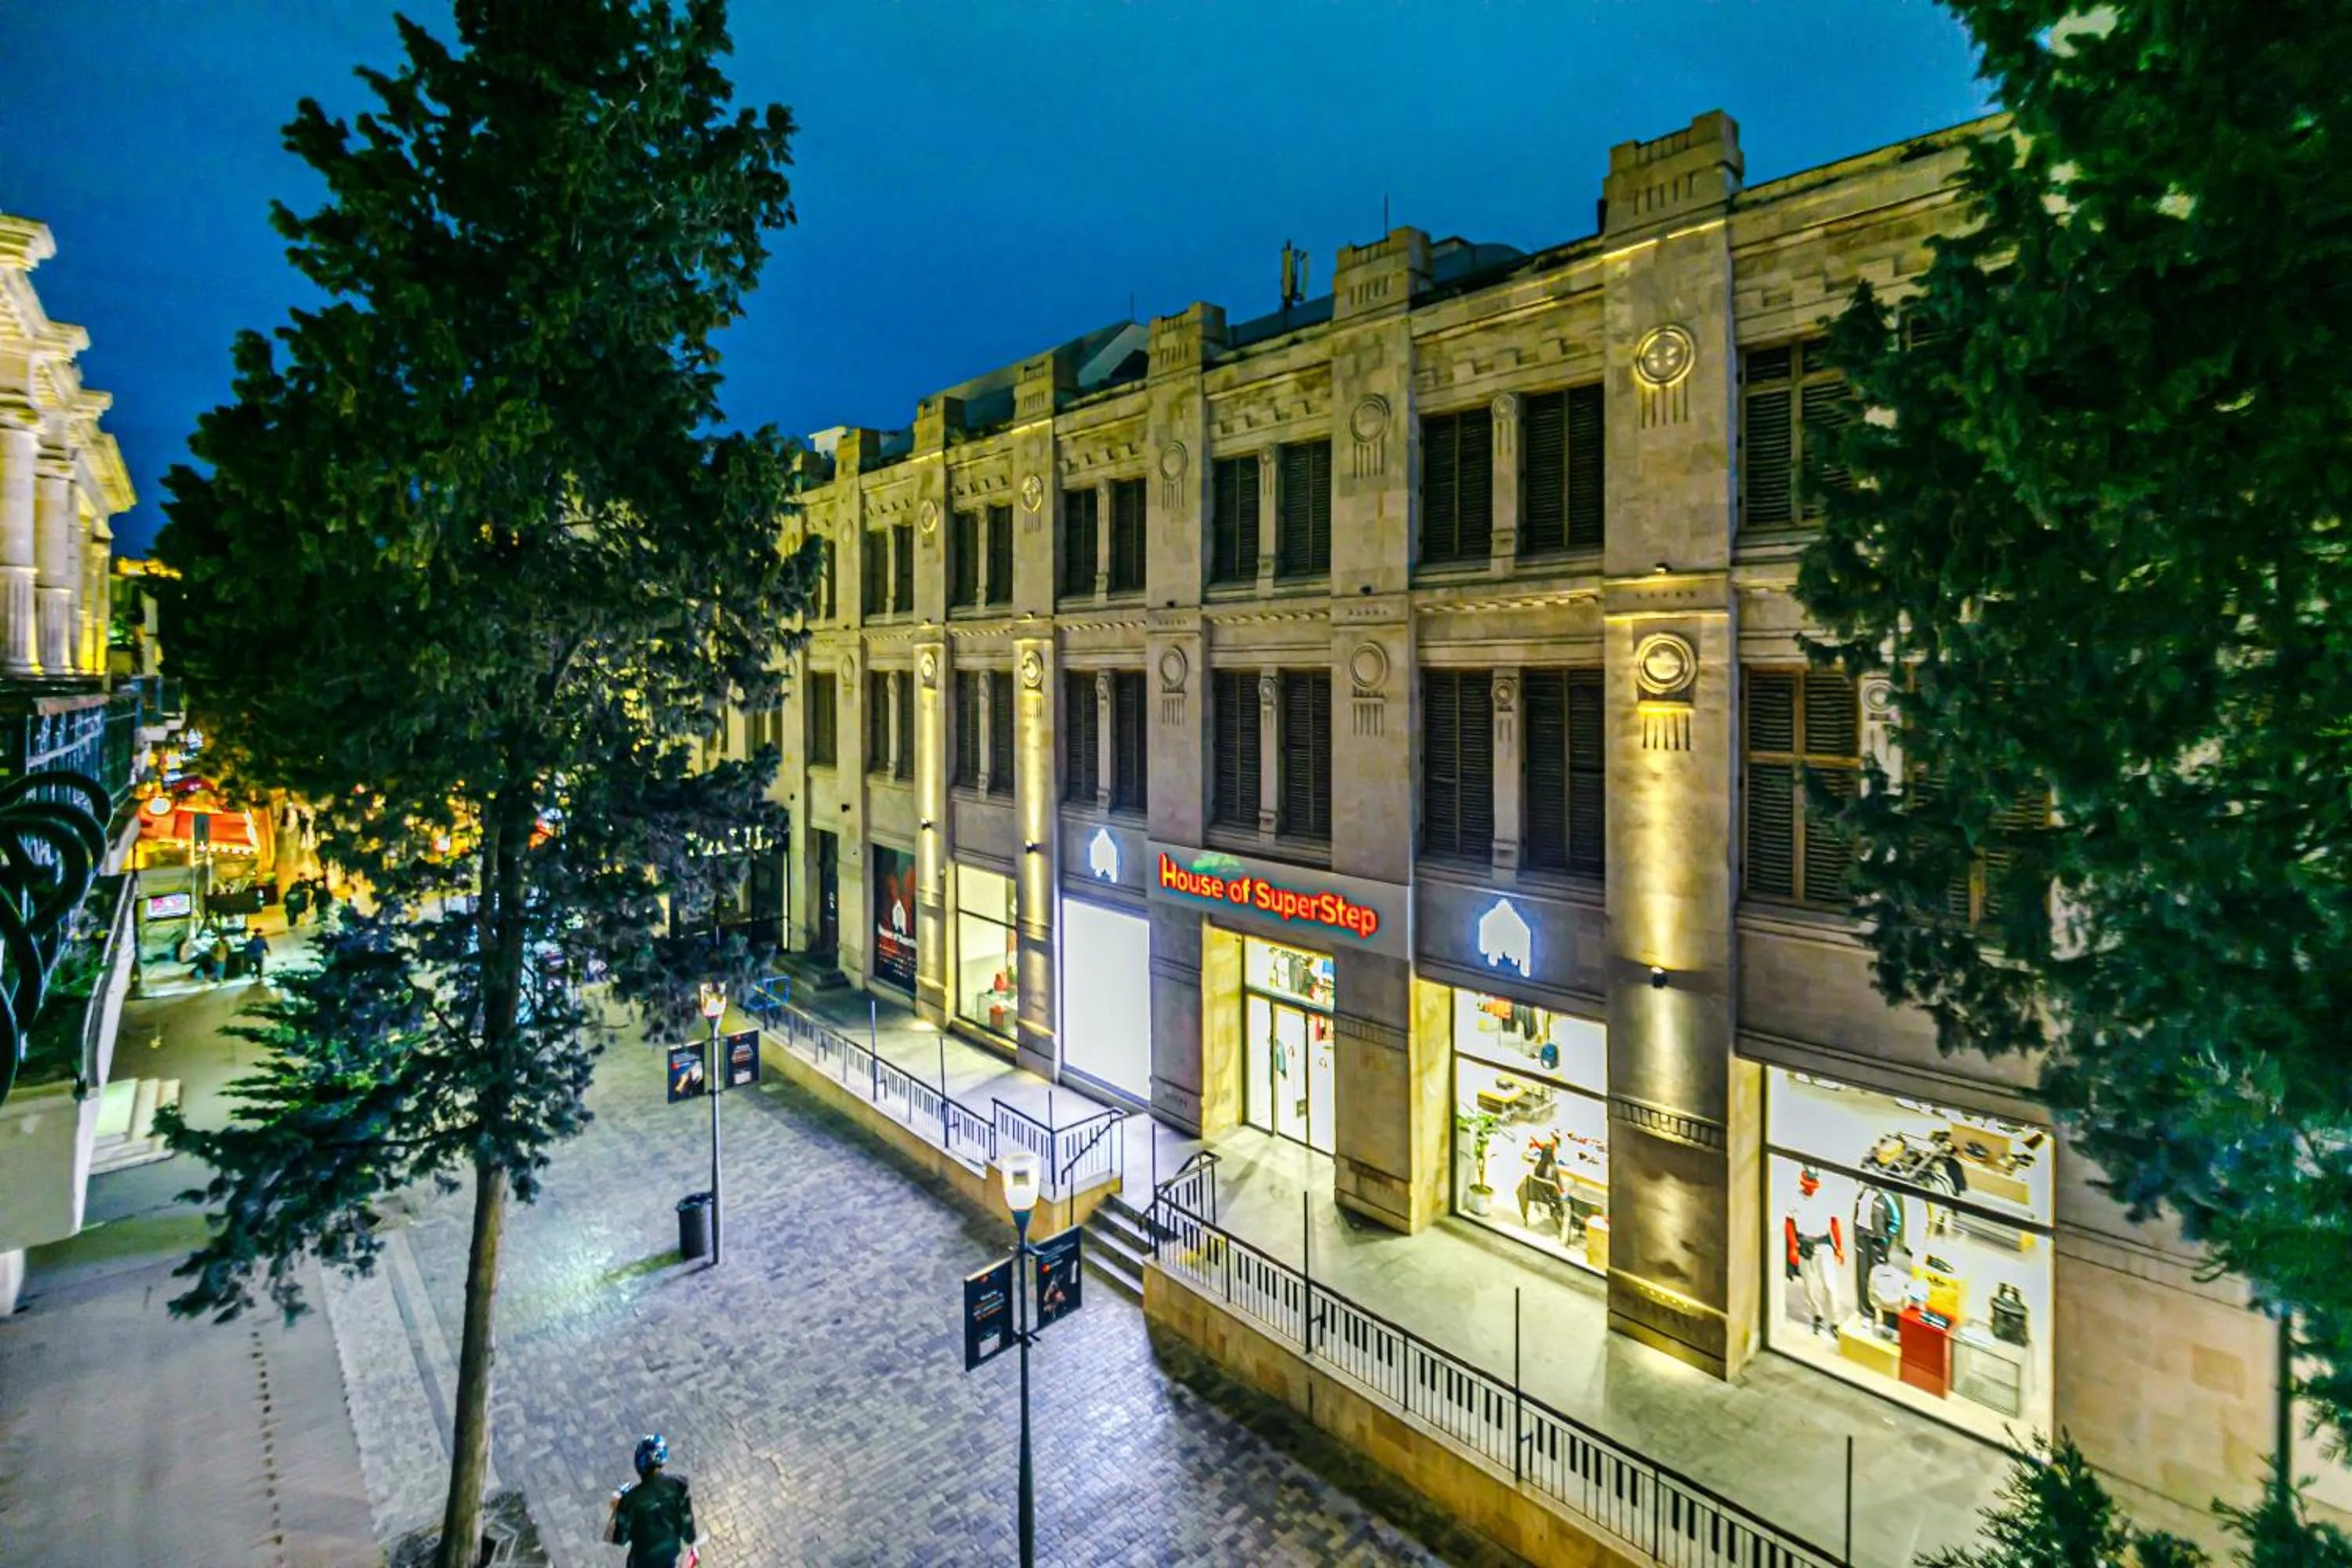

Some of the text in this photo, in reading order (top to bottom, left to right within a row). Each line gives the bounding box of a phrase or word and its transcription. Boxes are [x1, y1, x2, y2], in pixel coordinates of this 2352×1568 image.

[1159, 853, 1377, 938] House of SuperStep
